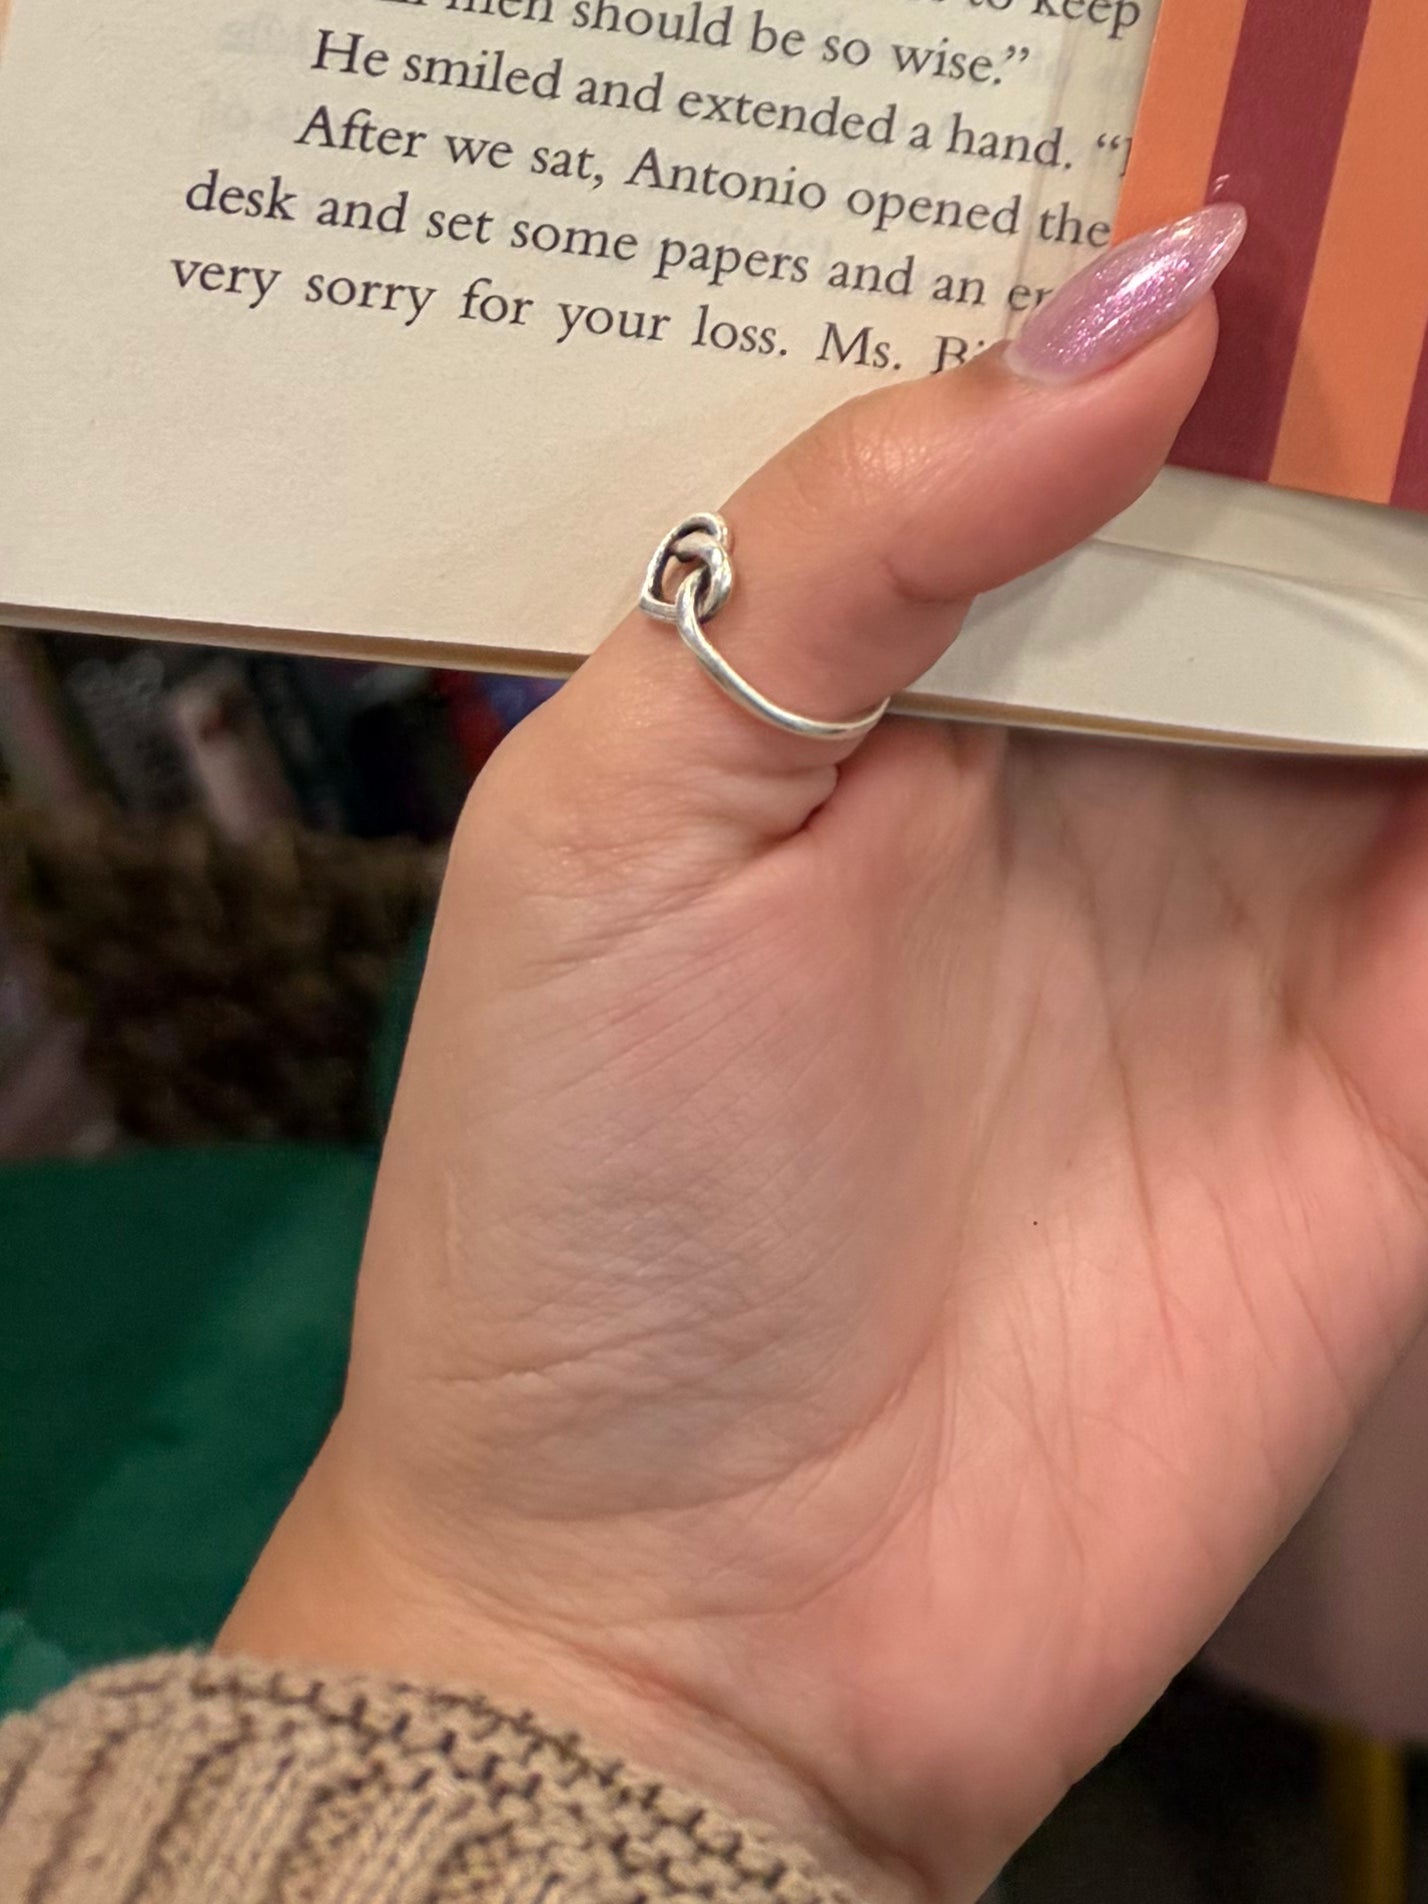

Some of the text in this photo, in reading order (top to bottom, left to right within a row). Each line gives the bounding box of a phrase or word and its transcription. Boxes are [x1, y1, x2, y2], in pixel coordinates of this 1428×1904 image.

[293, 104, 1111, 245] After we sat, Antonio opened the
[170, 259, 902, 370] very sorry for your loss. Ms.
